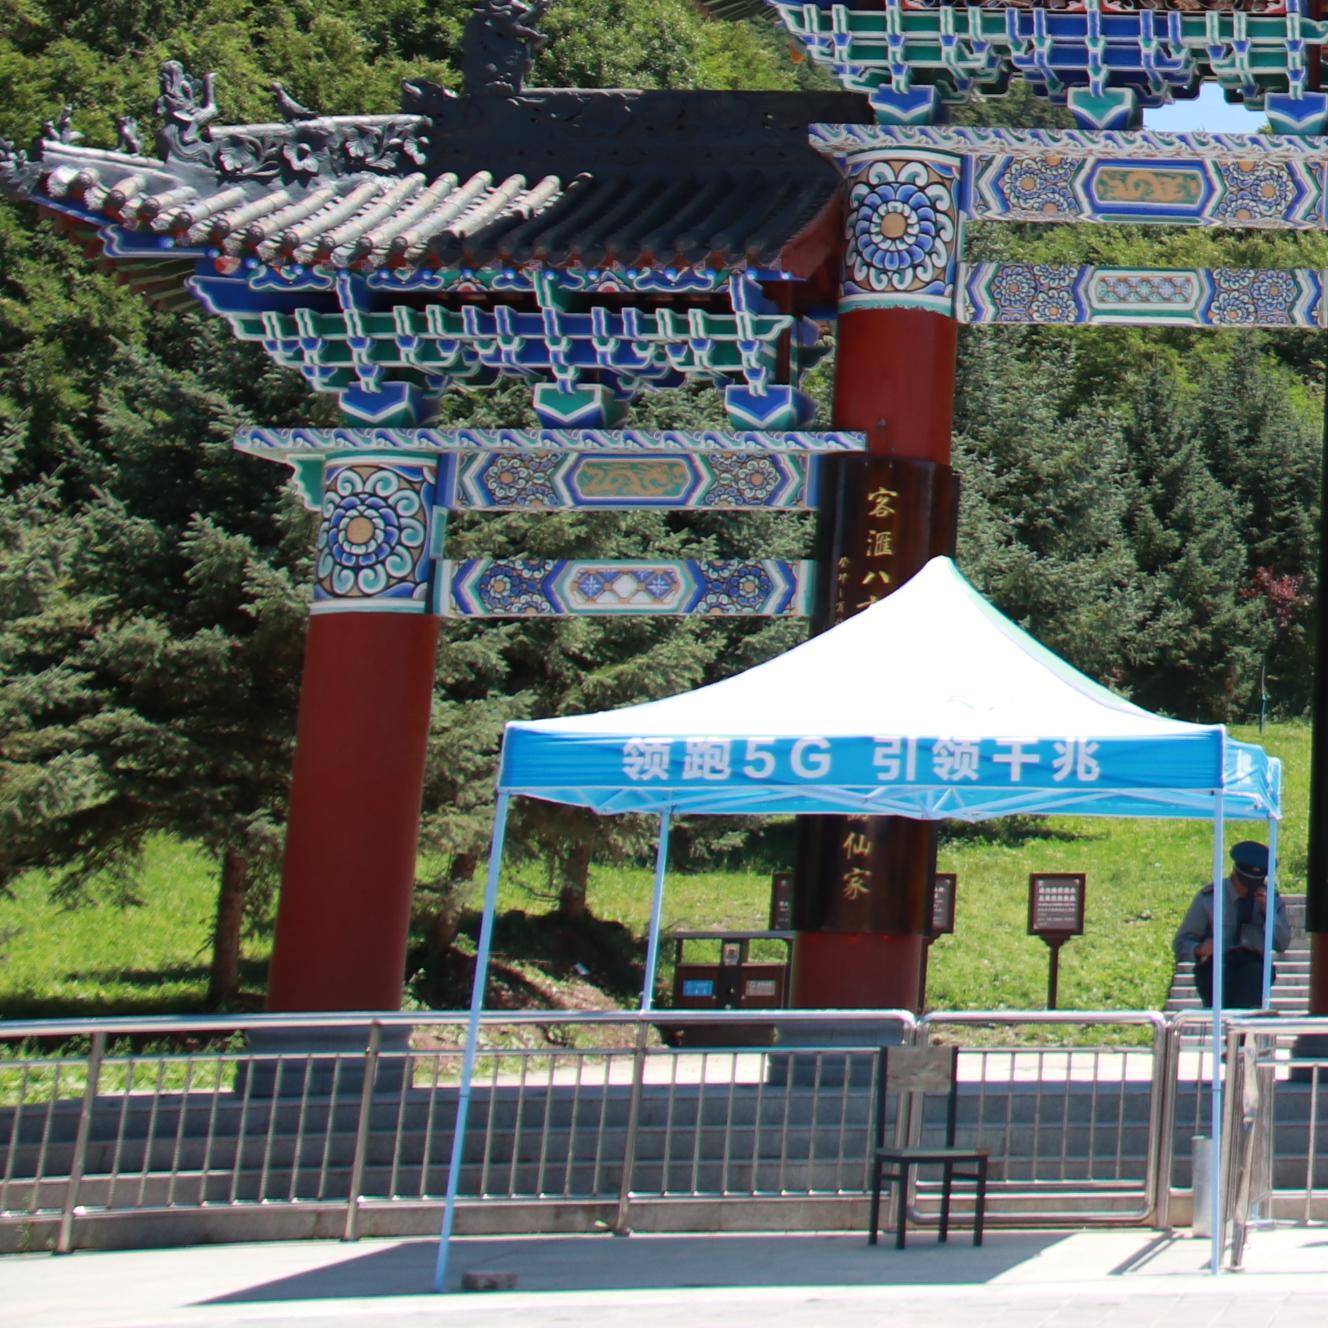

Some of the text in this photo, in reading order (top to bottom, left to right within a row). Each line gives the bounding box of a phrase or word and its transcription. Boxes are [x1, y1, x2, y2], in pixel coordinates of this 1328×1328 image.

[622, 735, 1101, 782] 领跑5G 引领千兆
